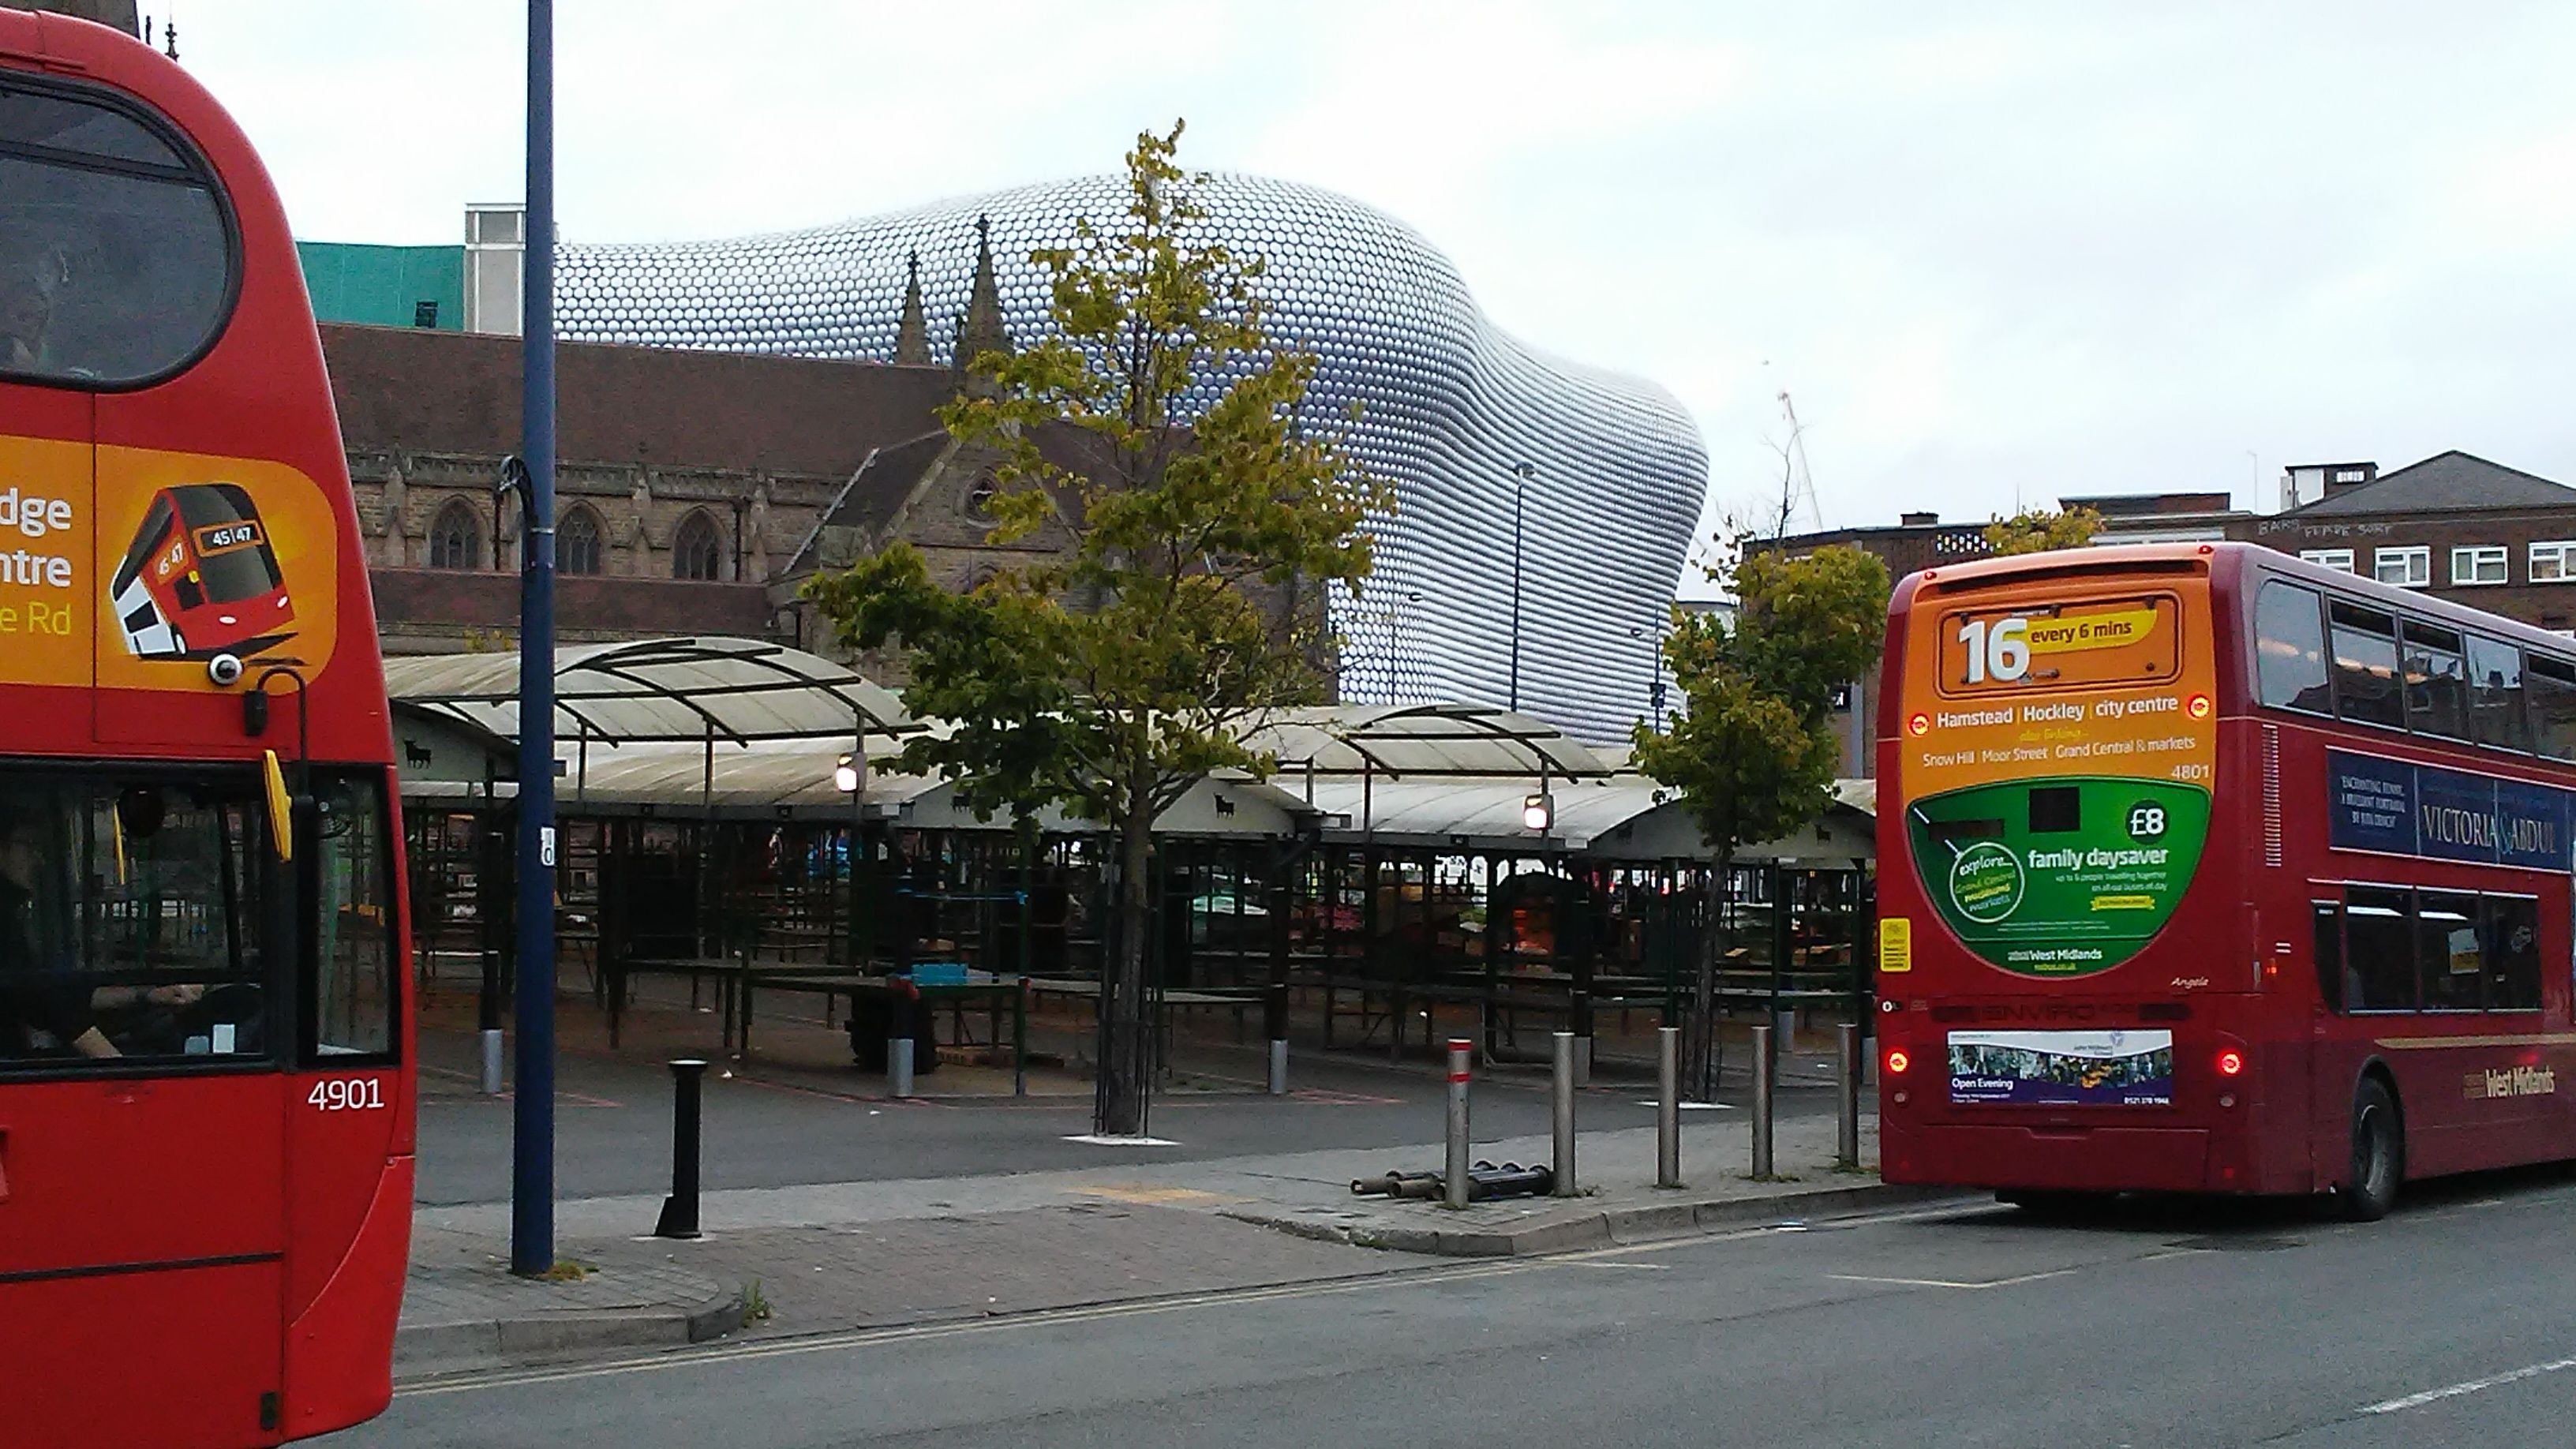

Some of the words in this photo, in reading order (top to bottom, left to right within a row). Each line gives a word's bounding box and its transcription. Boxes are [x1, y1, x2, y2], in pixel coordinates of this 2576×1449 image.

[28, 601, 72, 635] Rd
[2031, 627, 2076, 643] every
[2079, 623, 2090, 638] 6
[2093, 621, 2132, 637] mins
[1959, 618, 2030, 683] 16
[1937, 707, 2013, 728] Hamstead
[2023, 702, 2085, 721] Hockley
[2095, 699, 2125, 719] city
[2128, 697, 2179, 713] centre
[1923, 753, 1954, 767] Snow
[1956, 751, 1975, 764] Hill
[1982, 750, 2011, 762] Moor
[2013, 747, 2048, 761] Street
[2055, 743, 2091, 758] Grand
[2093, 739, 2134, 755] Central
[2147, 736, 2196, 751] markets
[2171, 764, 2210, 780] 4801
[2130, 808, 2164, 835] £8
[2422, 805, 2498, 848] VICTORIA
[2511, 818, 2556, 854] ABDUL
[2027, 848, 2084, 871] family
[2086, 847, 2169, 869] daysaver
[2029, 949, 2056, 960] West
[2057, 949, 2102, 960] Midlands
[308, 1078, 384, 1111] 4901
[1952, 1077, 1976, 1090] Open
[1977, 1077, 2013, 1090] Evening
[2486, 1069, 2514, 1098] West
[2514, 1065, 2556, 1096] Midlands
